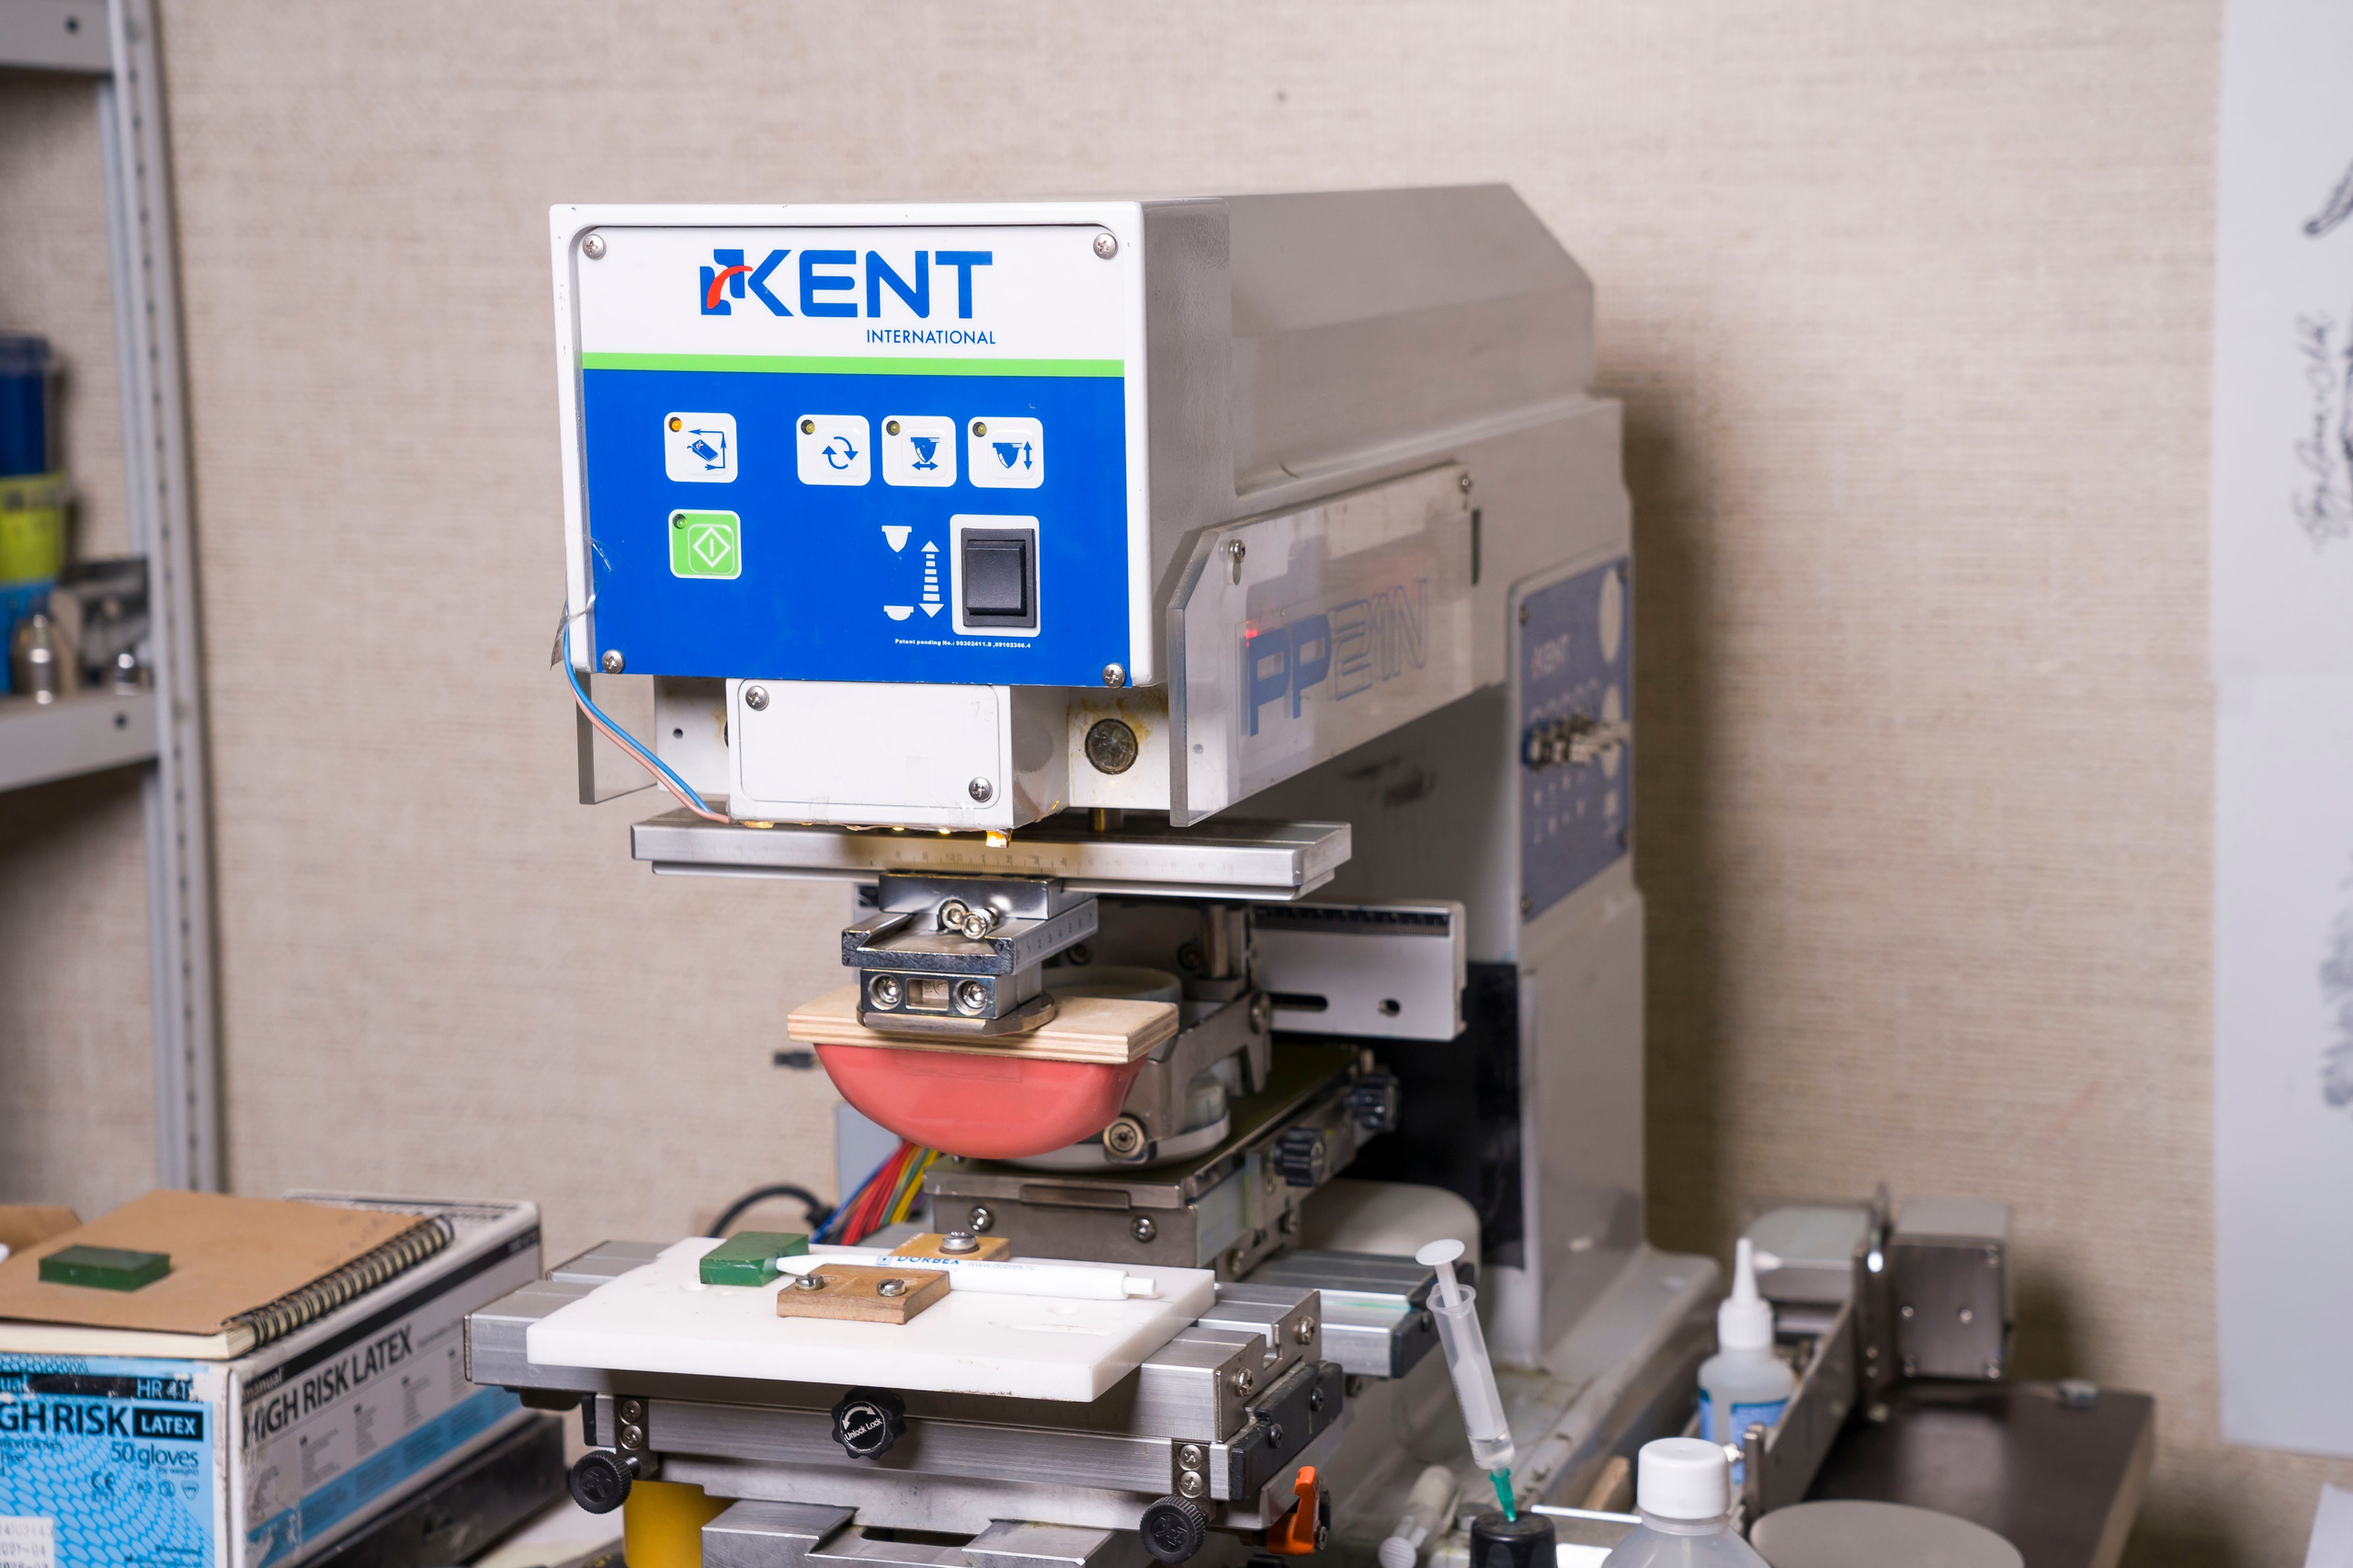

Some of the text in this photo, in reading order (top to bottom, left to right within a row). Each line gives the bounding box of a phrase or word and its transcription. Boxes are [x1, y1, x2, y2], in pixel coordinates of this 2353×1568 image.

[700, 248, 993, 319] KENT
[866, 329, 996, 345] INTERNATIONAL
[916, 639, 941, 647] pending
[302, 1358, 349, 1415] RISK
[352, 1322, 414, 1385] LATEX
[136, 1379, 163, 1400] HR
[52, 1403, 131, 1437] RISK
[141, 1414, 198, 1437] LATEX
[844, 1417, 883, 1441] Unlock Lock
[110, 1441, 199, 1471] 50 gloves
